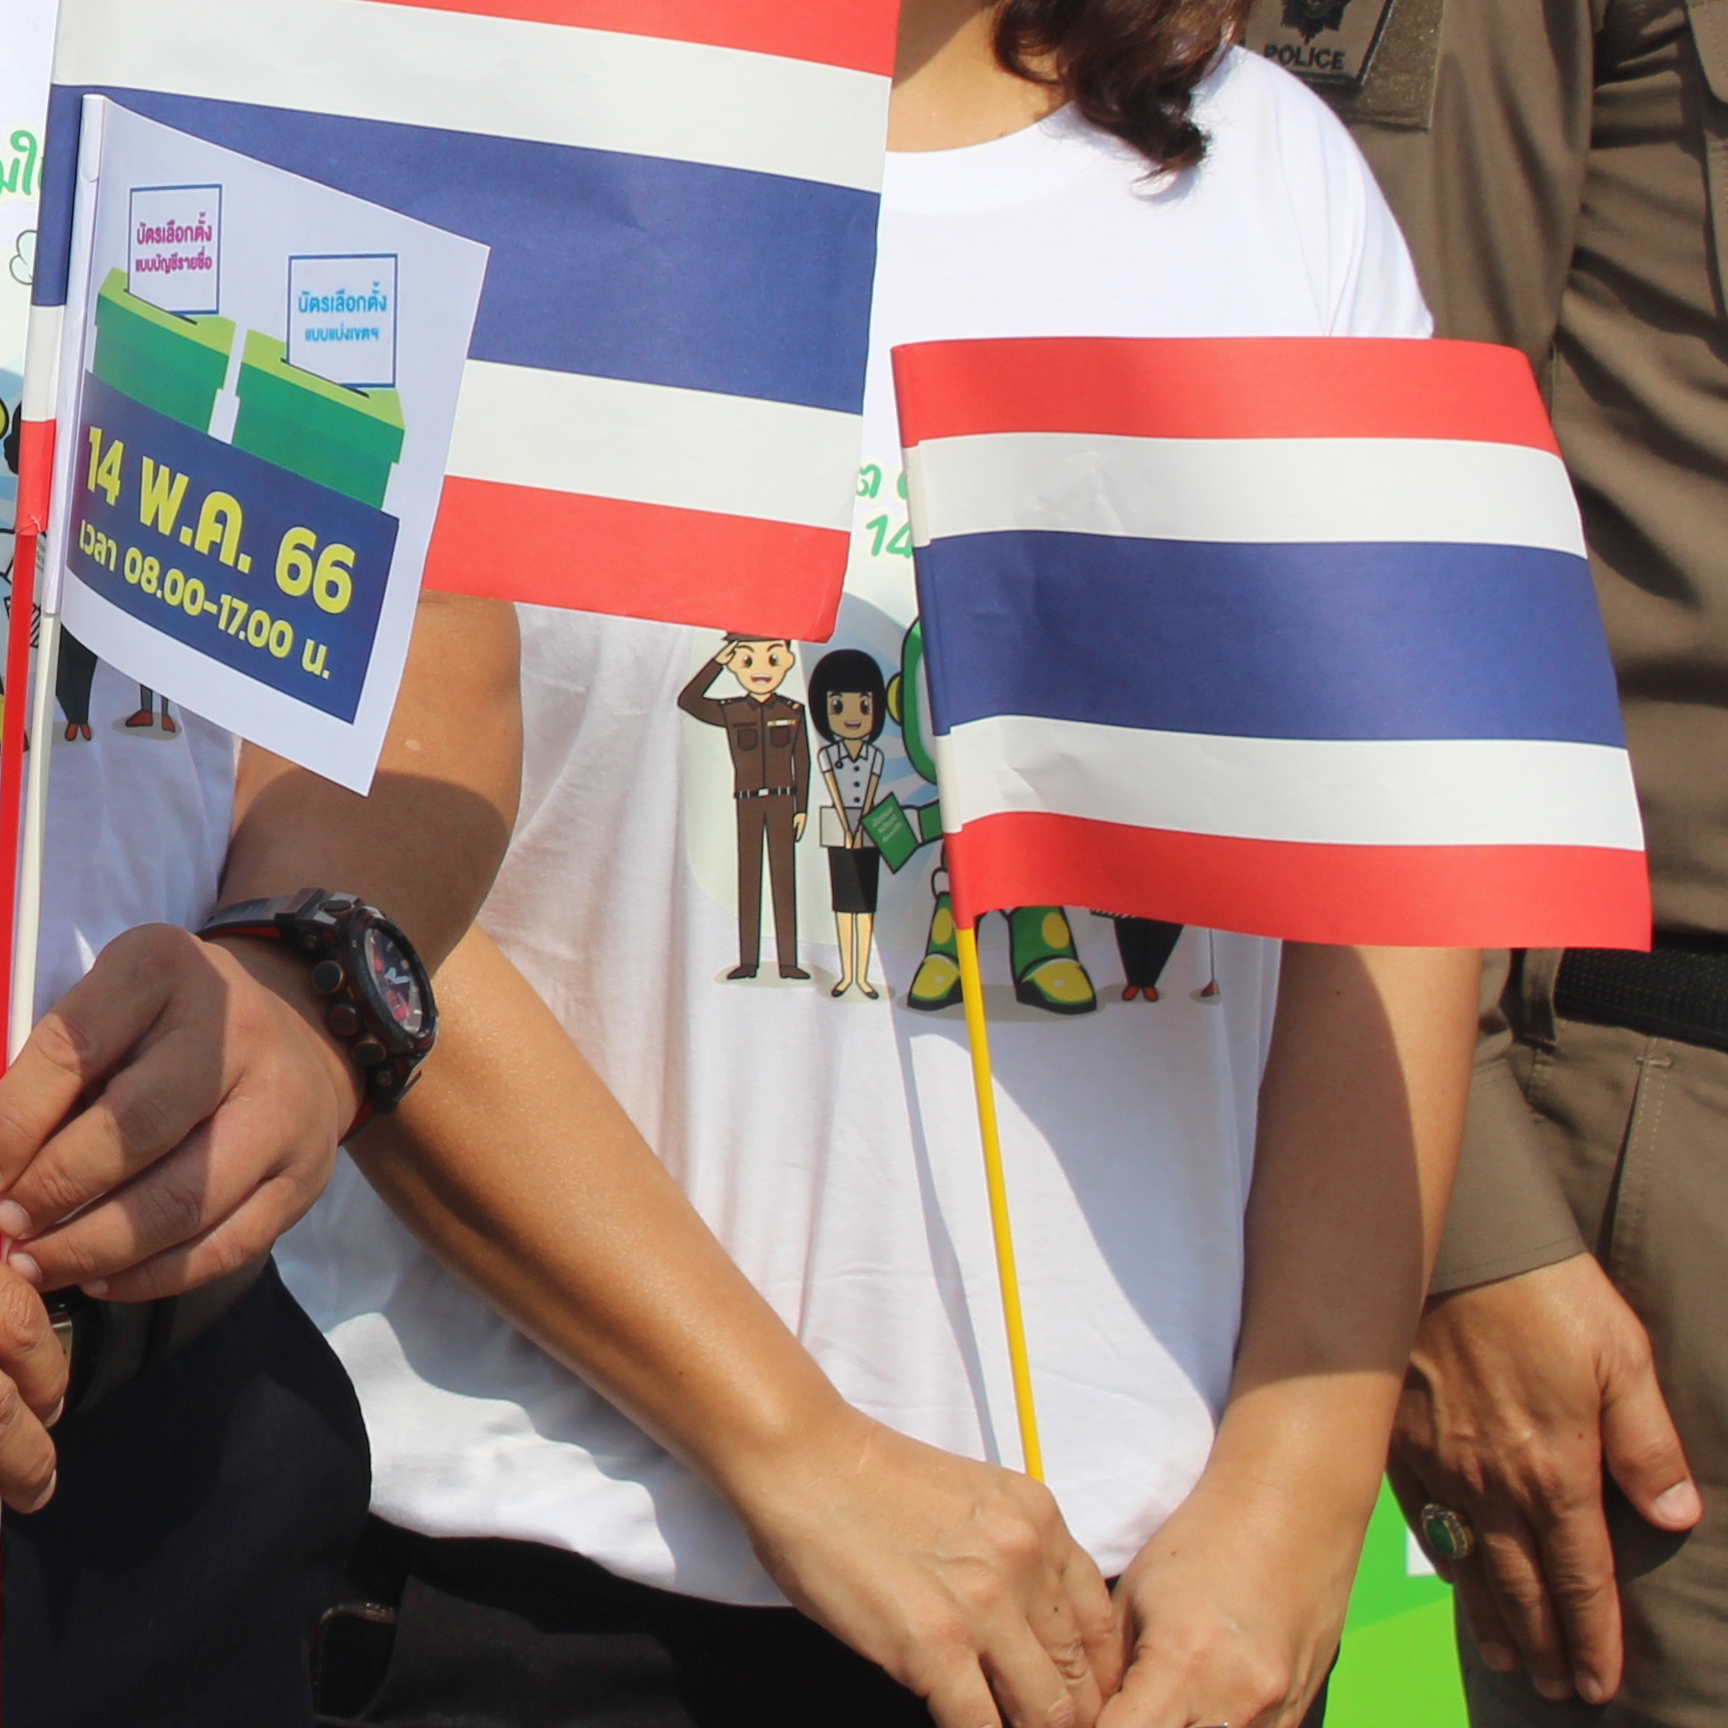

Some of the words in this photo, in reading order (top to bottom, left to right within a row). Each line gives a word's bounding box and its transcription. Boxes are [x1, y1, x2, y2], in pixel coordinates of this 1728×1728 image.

[1263, 43, 1346, 72] POLICE
[137, 211, 212, 246] บัตรเลือกตั้ง
[297, 281, 388, 316] บัตรเลือกตั้ง
[84, 426, 122, 508] 14
[139, 455, 252, 575] พ.ค.
[275, 526, 356, 615] 66
[79, 516, 117, 574] เวลา
[123, 552, 295, 660] 08.00-17.00
[301, 636, 331, 680] น.
